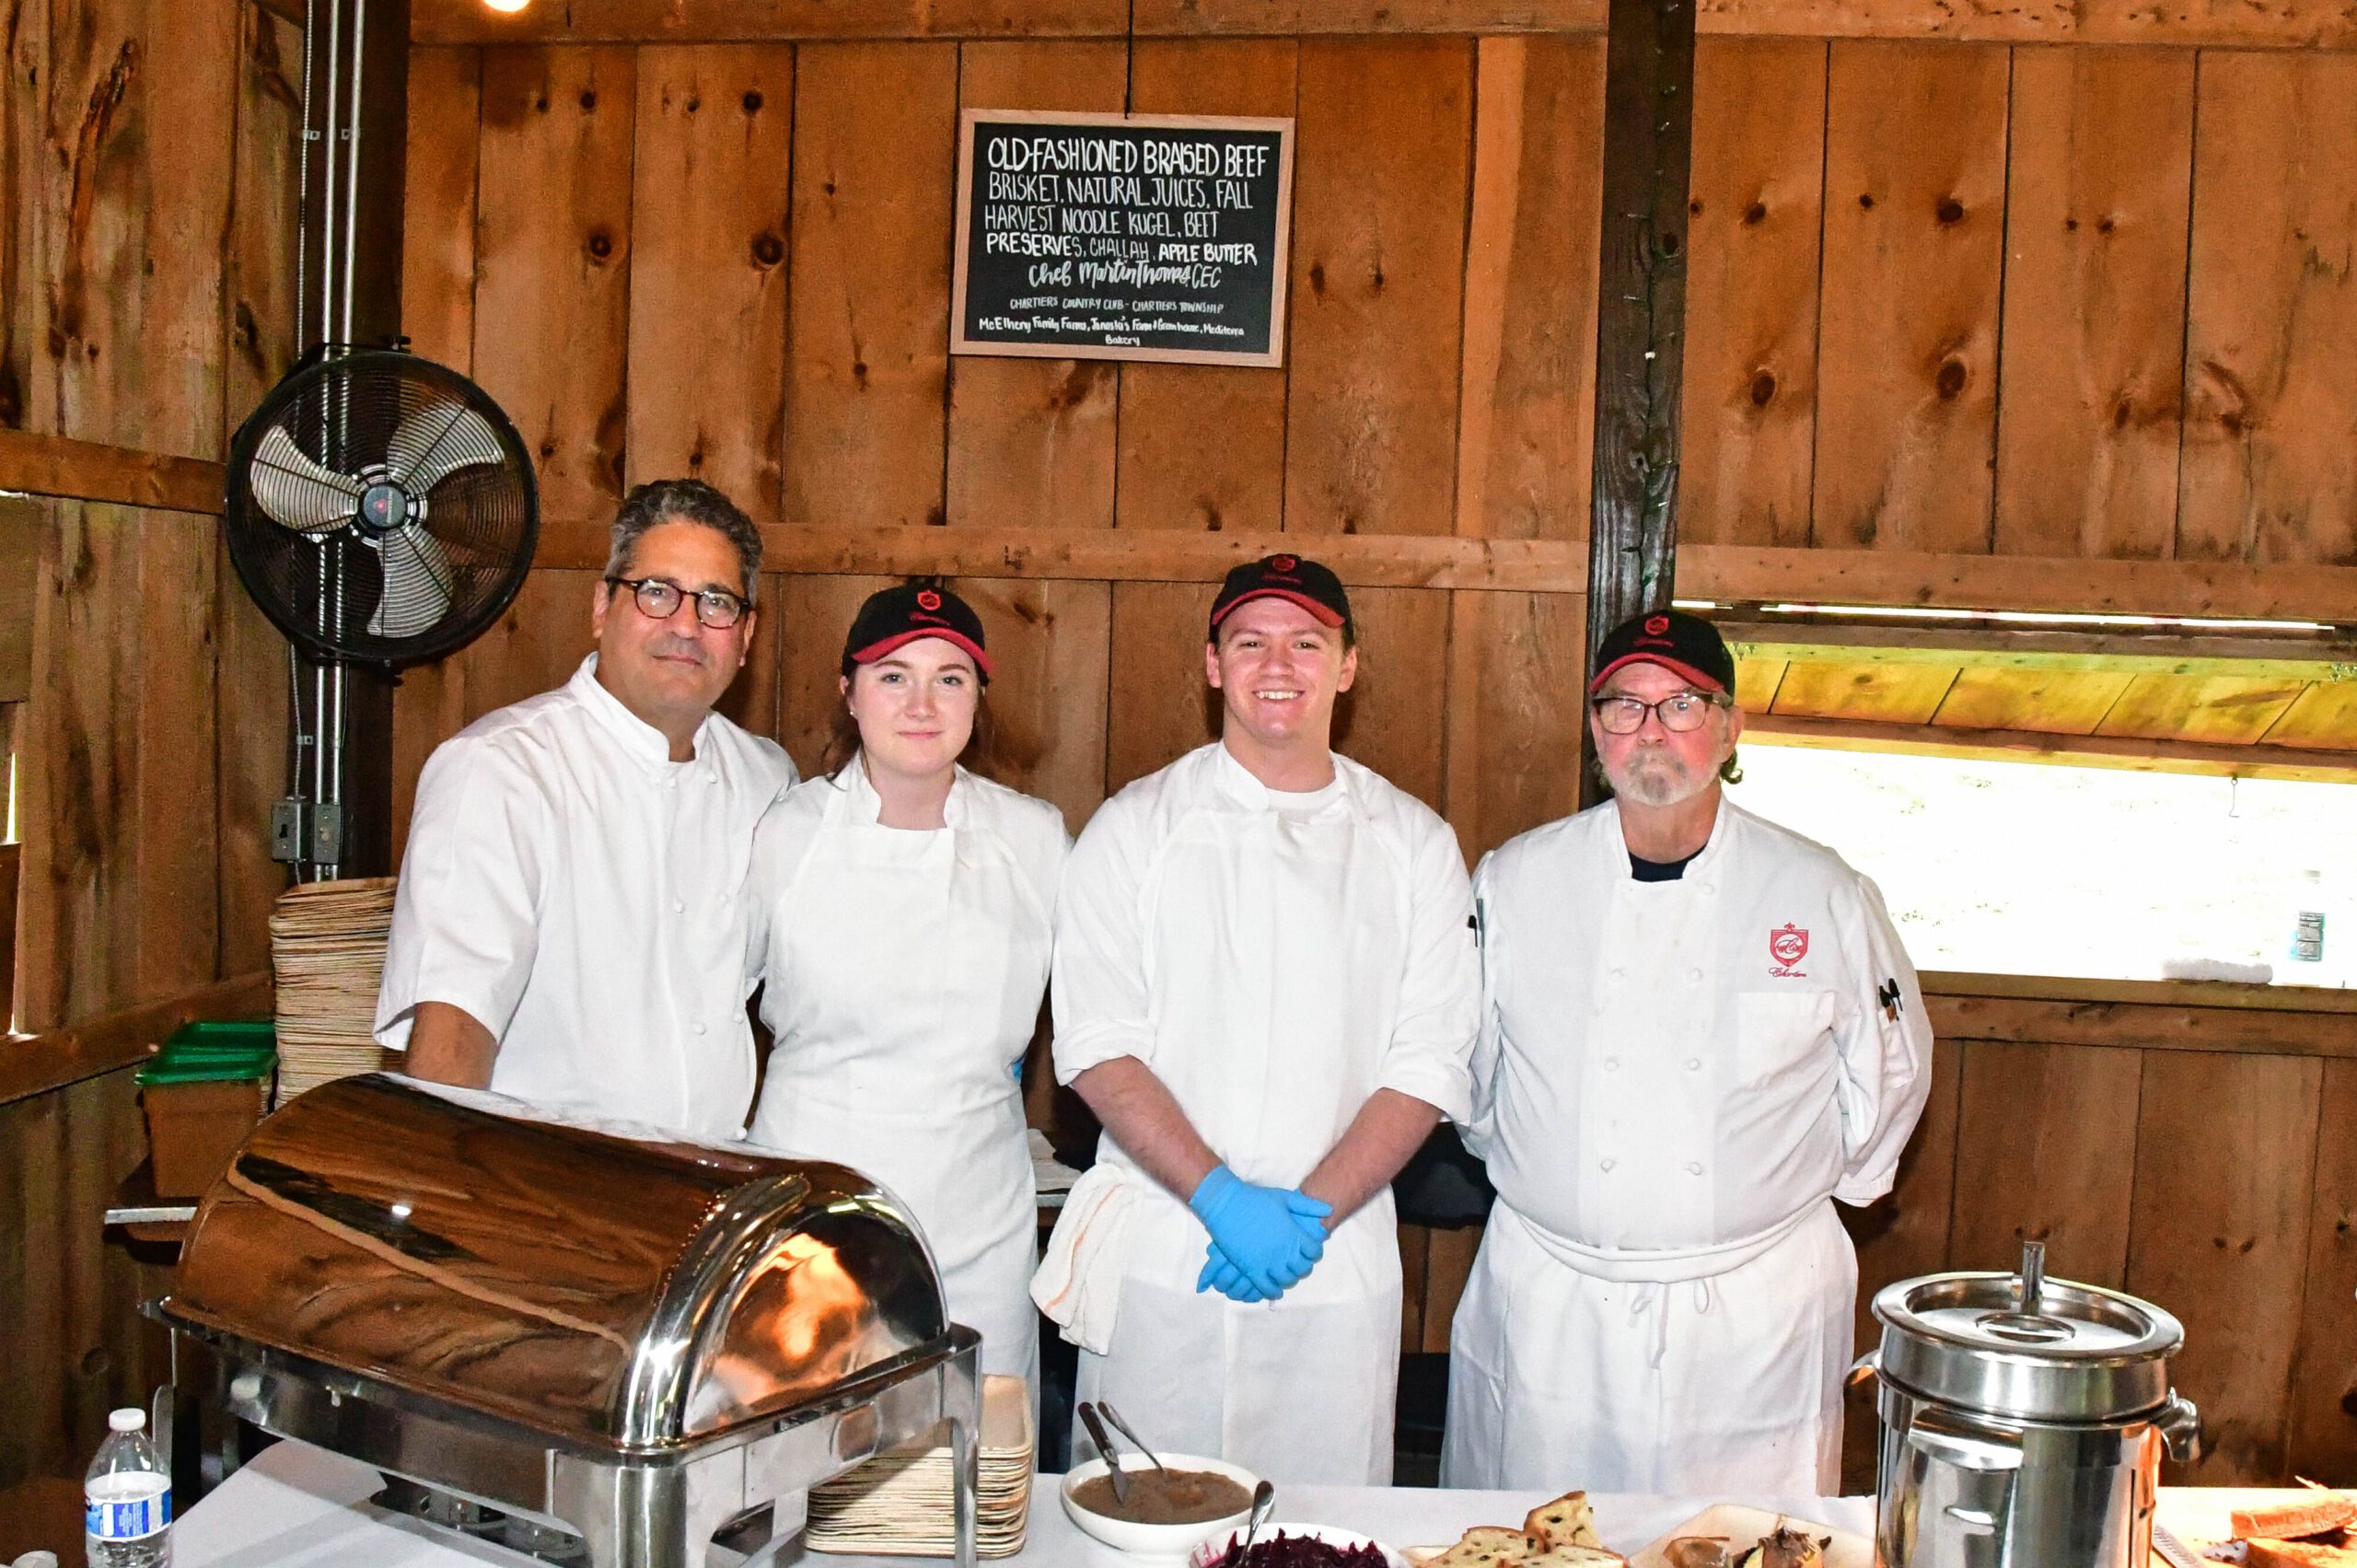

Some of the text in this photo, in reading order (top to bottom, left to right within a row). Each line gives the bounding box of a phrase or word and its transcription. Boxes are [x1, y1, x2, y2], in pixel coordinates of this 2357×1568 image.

[1144, 140, 1220, 176] BRAISED
[1225, 144, 1270, 177] BEEF
[1067, 176, 1150, 206] NATURAL
[1215, 180, 1253, 210] FALL
[985, 204, 1219, 238] HARVEST NOODLE KUGEL, BEET
[986, 232, 1086, 257] PRESERVES,
[1158, 243, 1200, 262] APPLE
[1203, 243, 1257, 265] BUTTER
[1028, 261, 1072, 287] Chef
[1191, 263, 1222, 289] CEC
[1010, 296, 1058, 309] CHARTIERS
[1062, 298, 1101, 309] COUNTRY
[1132, 301, 1178, 311] CHARTIERS
[1178, 302, 1224, 314] TOWNSHIP
[1032, 316, 1060, 332] Family
[1105, 334, 1141, 346] Bakery
